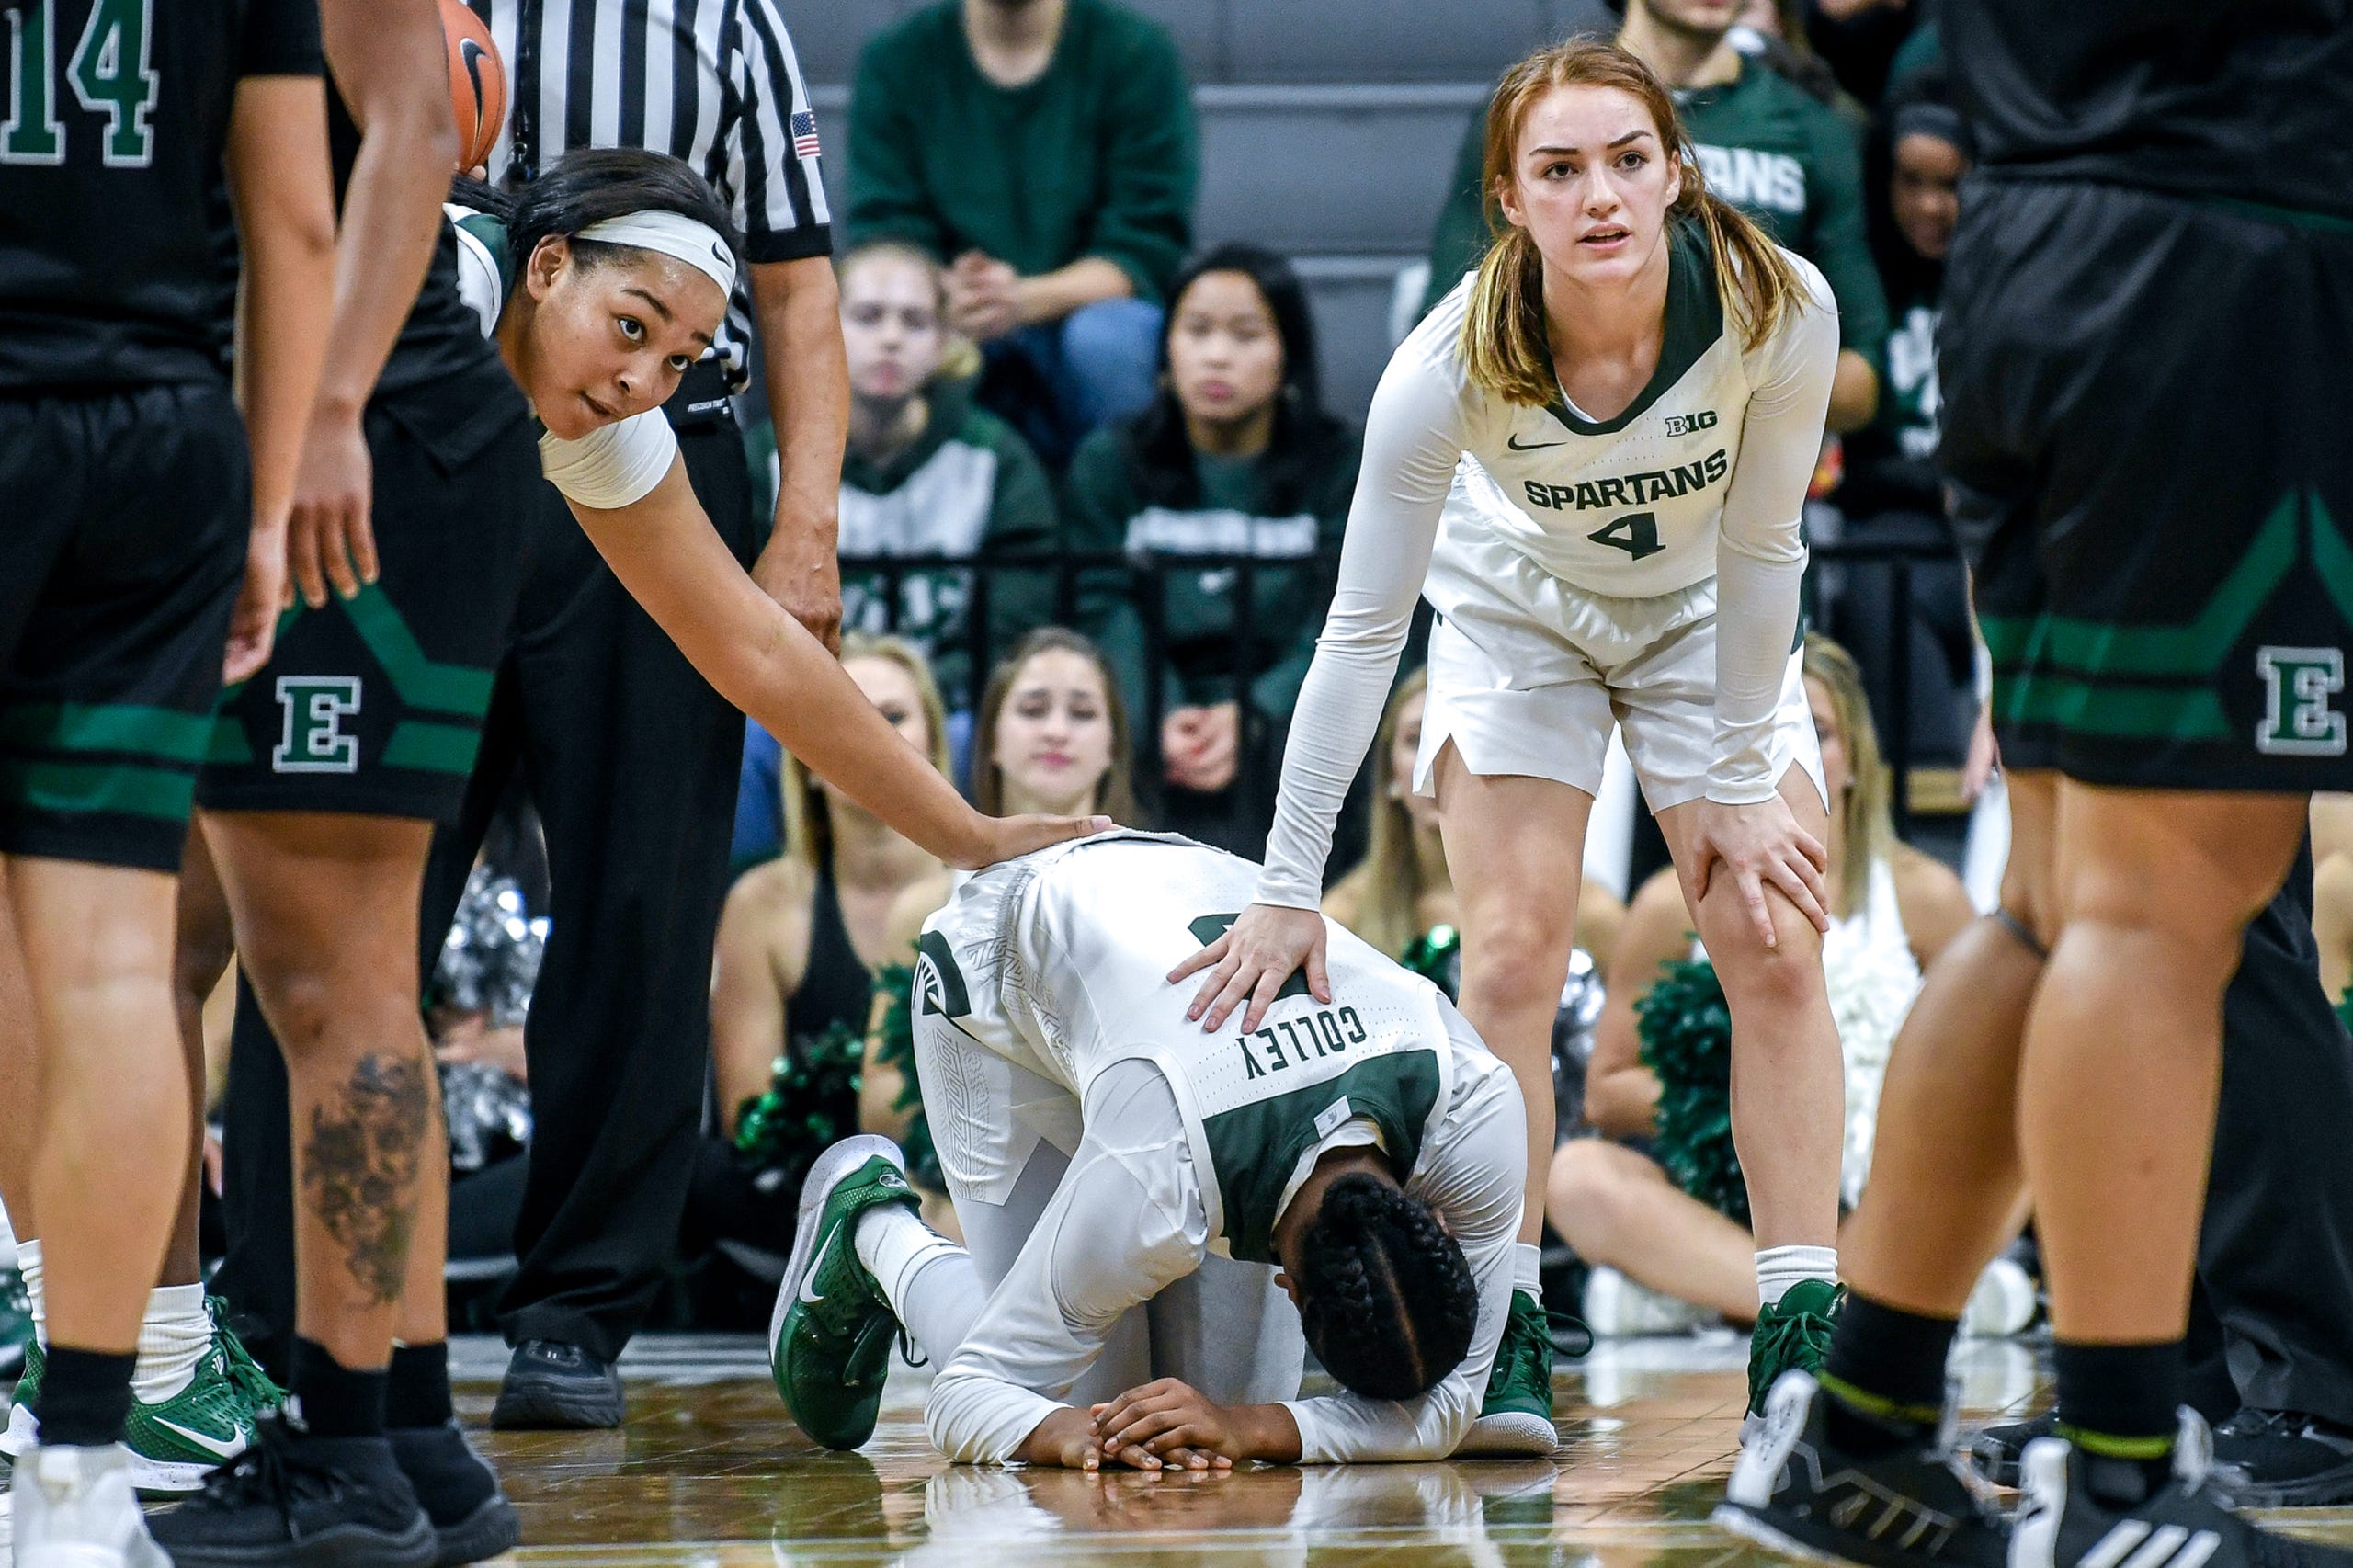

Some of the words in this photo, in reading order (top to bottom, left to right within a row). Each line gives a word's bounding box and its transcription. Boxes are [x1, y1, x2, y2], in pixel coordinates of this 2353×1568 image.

[0, 0, 160, 167] 14
[1524, 449, 1727, 510] SPARTANS
[1586, 511, 1666, 562] 4
[272, 675, 362, 774] E
[2255, 645, 2347, 756] E
[1235, 1006, 1368, 1080] COLLEY
